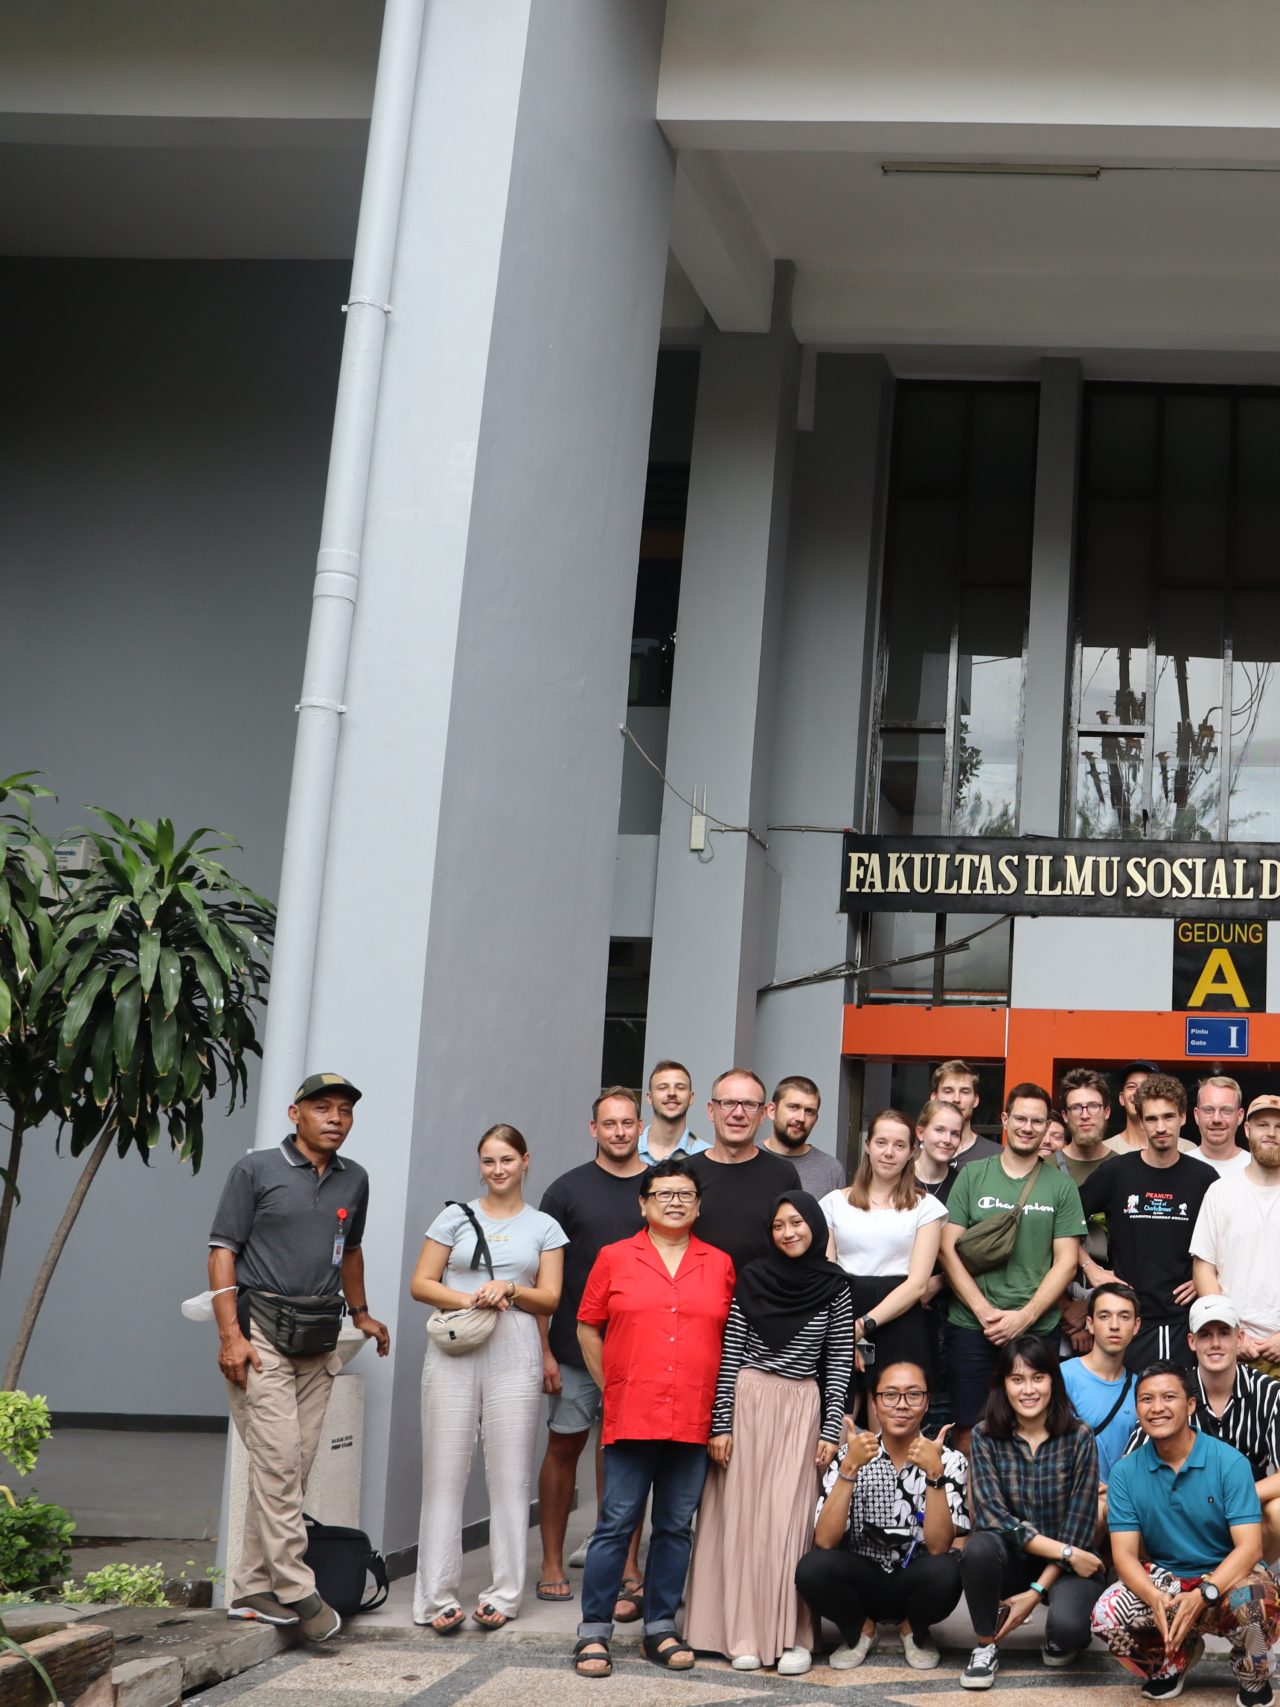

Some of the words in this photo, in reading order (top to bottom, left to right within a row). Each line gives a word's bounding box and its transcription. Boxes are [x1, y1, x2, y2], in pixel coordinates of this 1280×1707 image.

[846, 853, 1018, 895] FAKULTAS
[1024, 855, 1121, 897] ILMU
[1126, 857, 1254, 899] SOSIAL
[1178, 923, 1263, 943] GEDUNG
[1187, 948, 1250, 1008] A
[978, 1196, 1055, 1215] Chapion
[1145, 1192, 1173, 1200] PEANUTS
